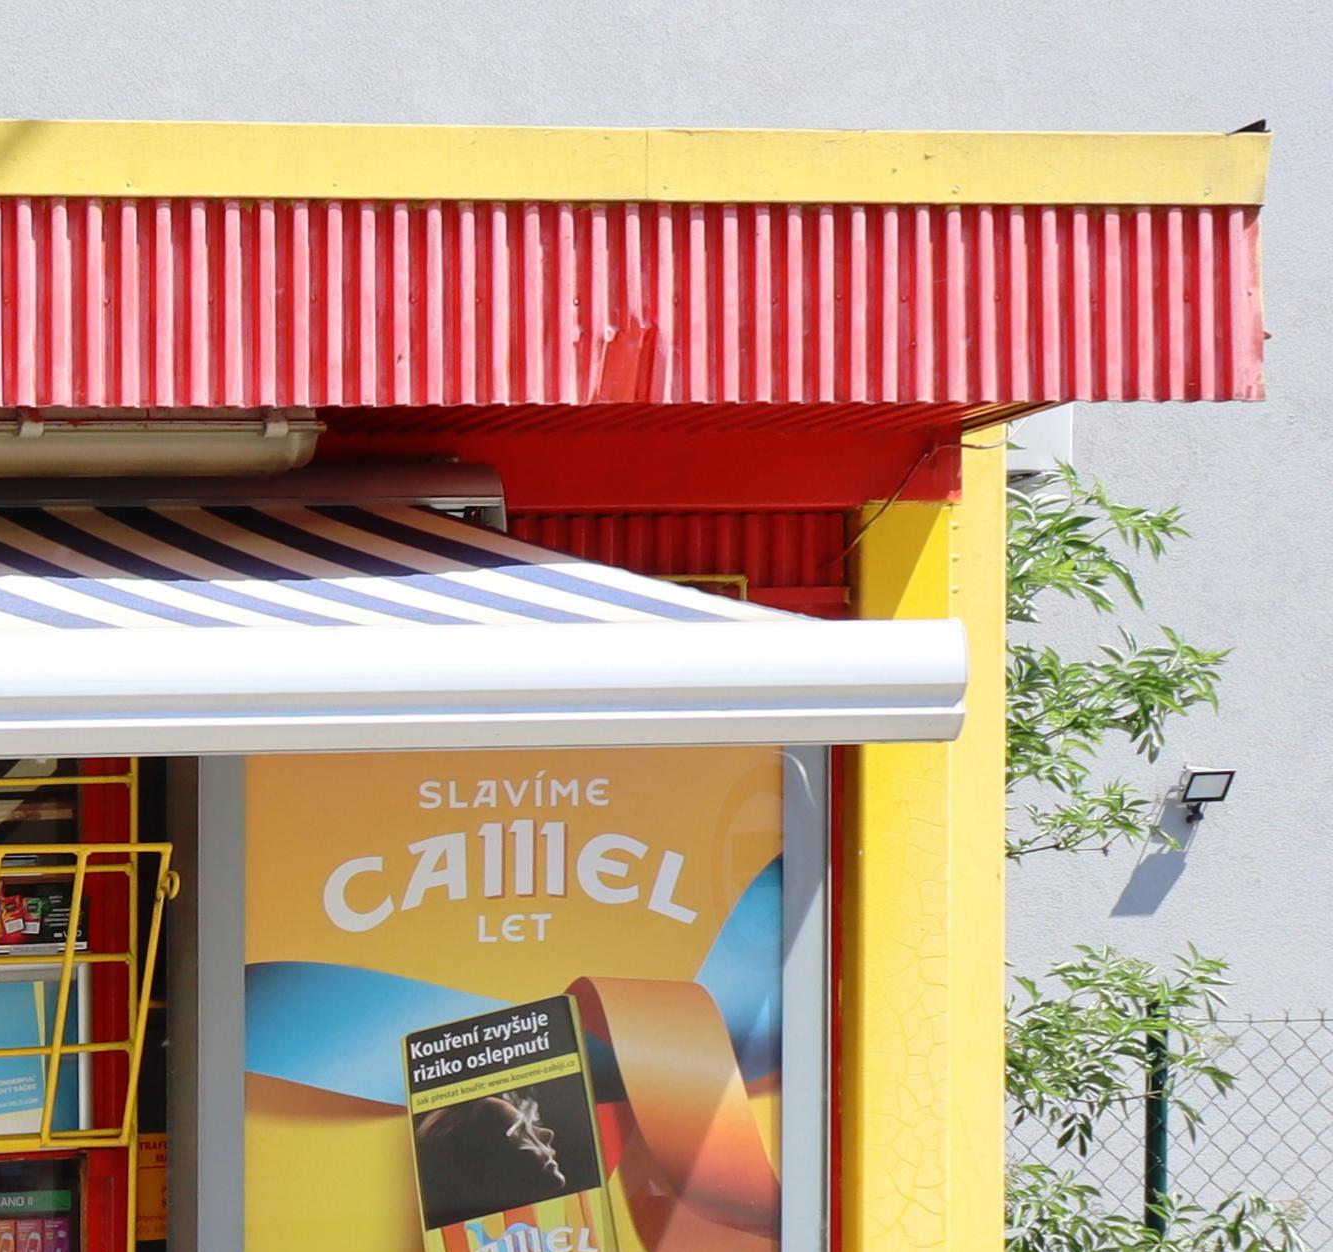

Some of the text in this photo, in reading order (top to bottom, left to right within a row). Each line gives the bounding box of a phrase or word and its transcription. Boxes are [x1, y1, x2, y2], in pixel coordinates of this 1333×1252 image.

[418, 770, 611, 809] SLAVÍME
[477, 912, 553, 943] LET
[409, 1010, 550, 1061] Kouření zvyšuje
[412, 1031, 551, 1084] riziko oslepnutí
